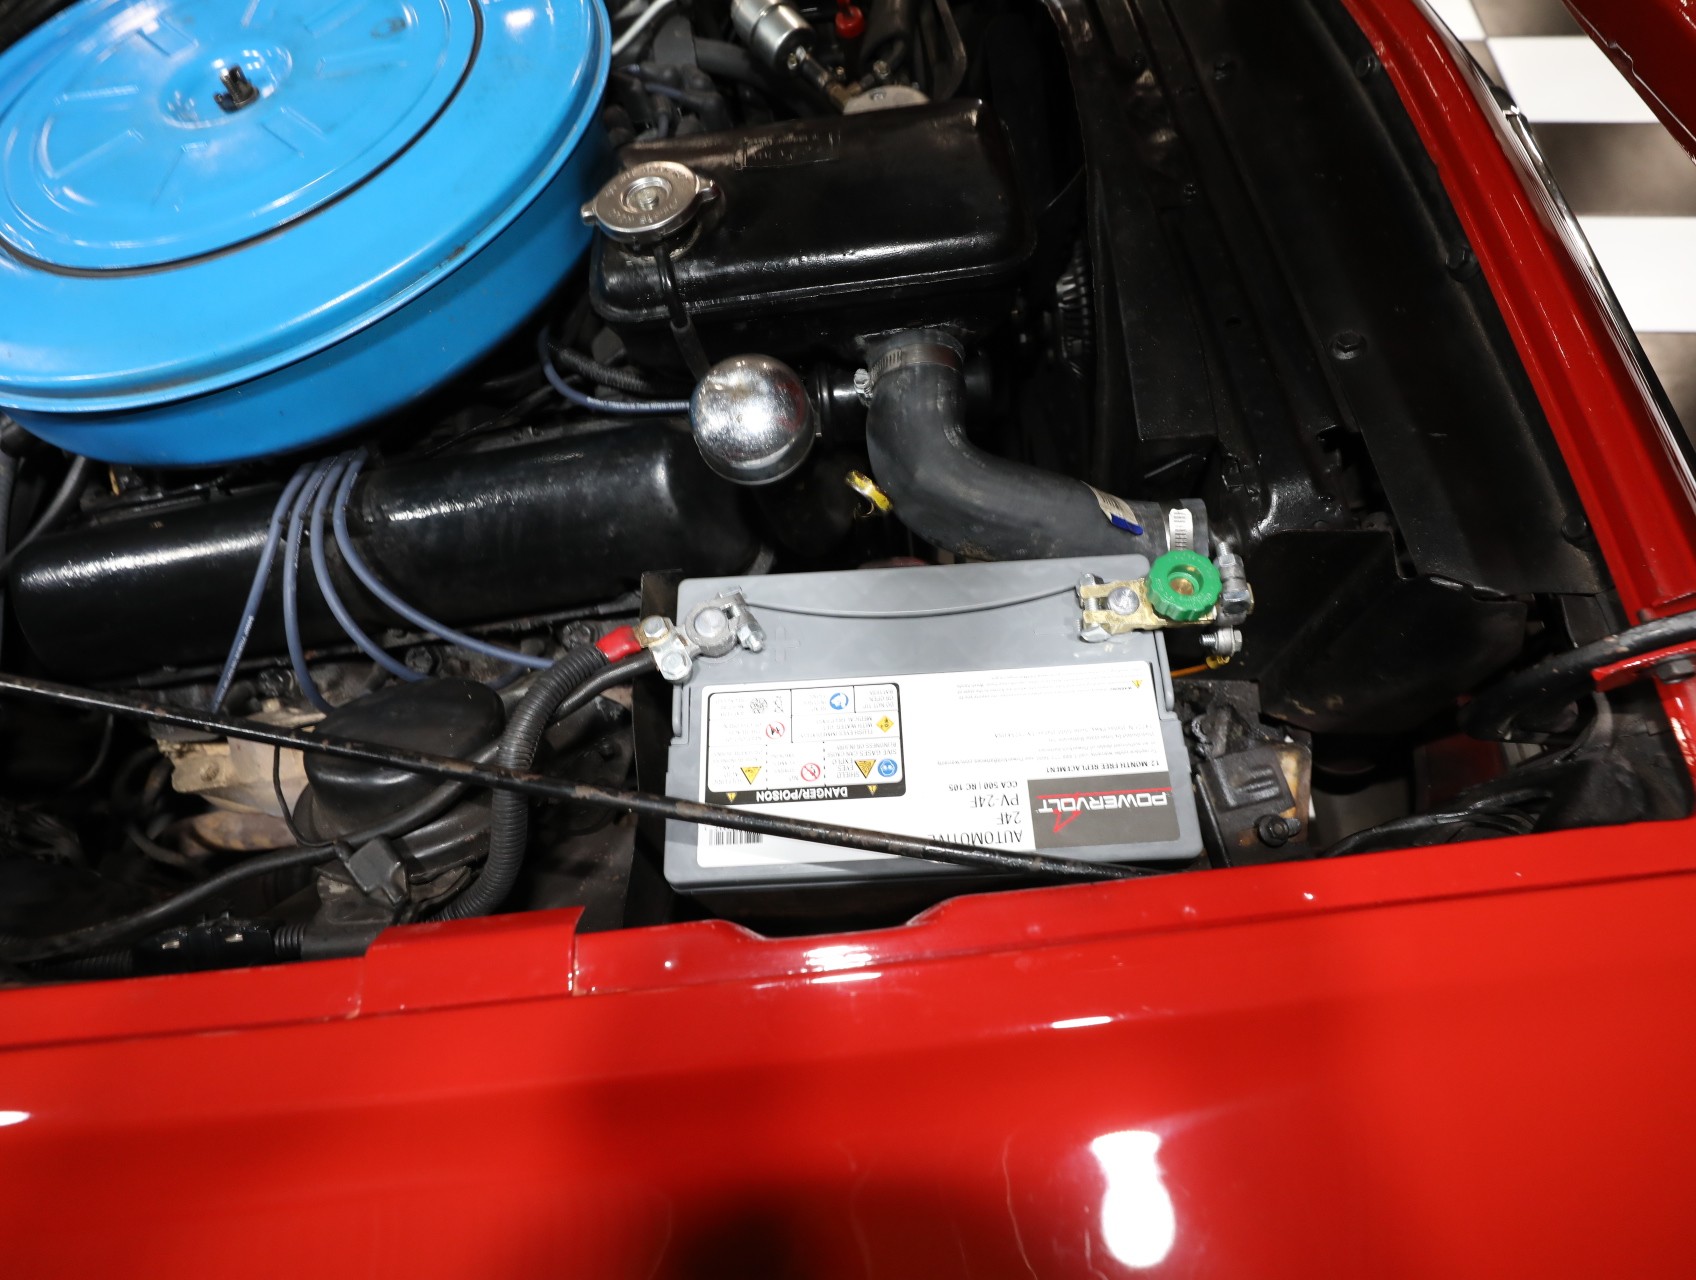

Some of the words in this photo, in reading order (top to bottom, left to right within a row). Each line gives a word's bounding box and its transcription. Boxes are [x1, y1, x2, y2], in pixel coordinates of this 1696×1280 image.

[1046, 764, 1099, 773] REPLACEMENT
[983, 781, 999, 790] 500
[1001, 781, 1018, 789] CCA
[757, 786, 848, 802] DANGER/POISON
[970, 793, 1019, 808] PV-24F
[1038, 792, 1168, 814] POWERVOLT
[996, 811, 1022, 825] 24F
